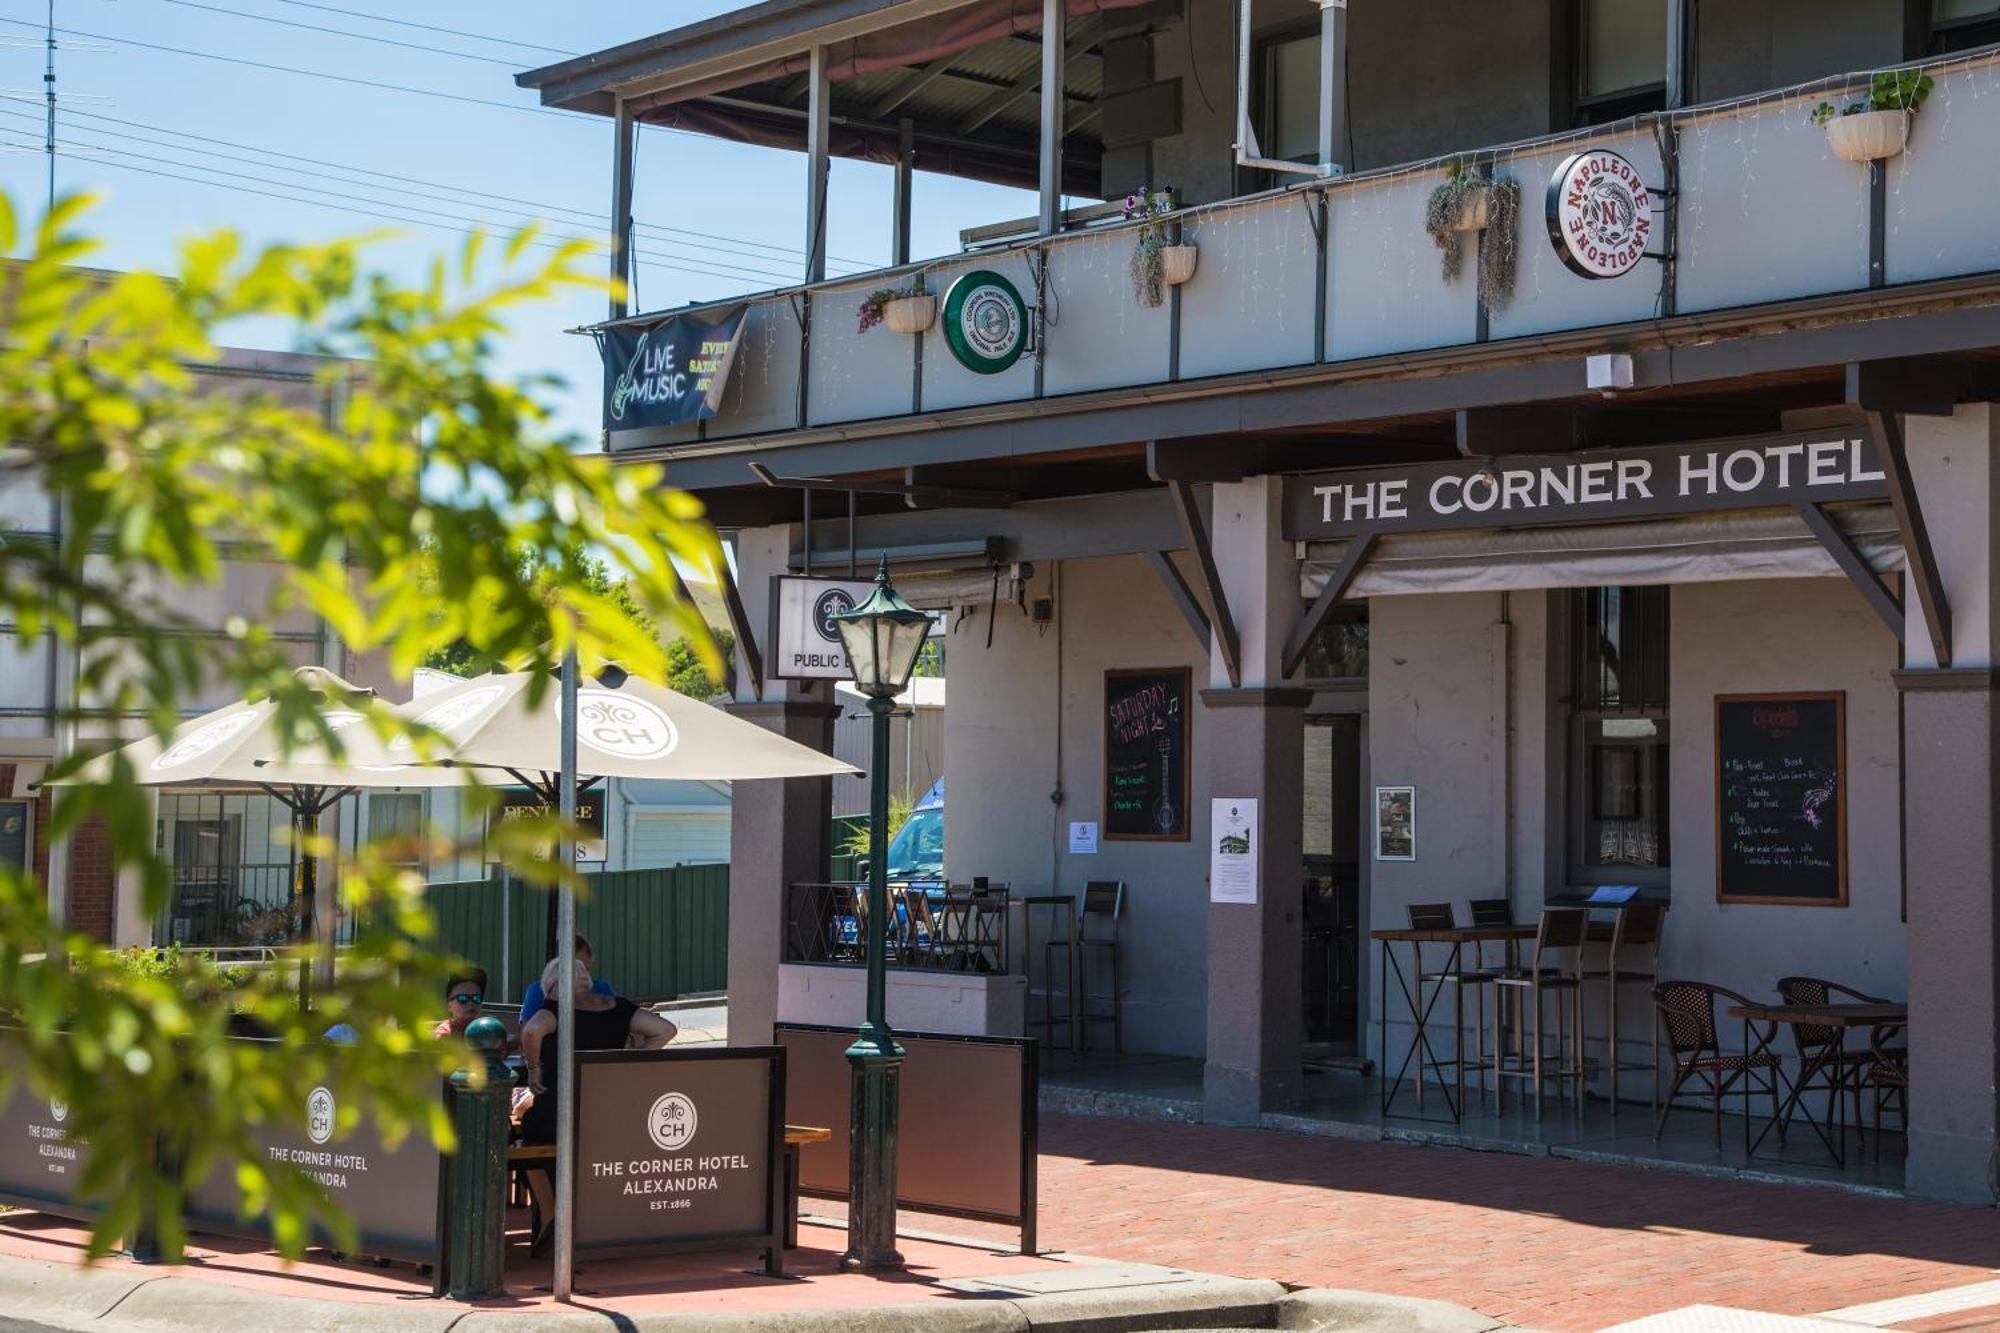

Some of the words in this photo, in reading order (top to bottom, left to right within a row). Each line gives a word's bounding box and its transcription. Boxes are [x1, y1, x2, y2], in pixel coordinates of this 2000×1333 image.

[1568, 157, 1649, 209] NAPOLEONE
[1601, 200, 1617, 225] N
[1568, 217, 1650, 268] NAPOLEONE
[644, 344, 675, 374] LIVE
[630, 373, 686, 403] MUSIC
[1313, 479, 1408, 522] THE
[1429, 459, 1654, 515] CORNER
[1679, 439, 1886, 496] HOTEL
[794, 653, 839, 668] PUBLIC
[1110, 682, 1168, 728] SATURDAY
[592, 727, 656, 745] CH
[1120, 715, 1149, 745] NIGHT
[28, 1124, 41, 1138] THE
[311, 1117, 328, 1131] CH
[659, 1123, 685, 1137] CH
[39, 1144, 76, 1160] ALEXANDRA
[269, 1147, 289, 1161] THE
[291, 1150, 332, 1167] CORNER
[334, 1154, 368, 1171] HOTEL
[592, 1161, 624, 1177] THE
[628, 1157, 694, 1175] CORNER
[699, 1155, 749, 1171] HOTEL
[623, 1176, 719, 1195] ALEXANDRA
[650, 1199, 692, 1210] EST.1866
